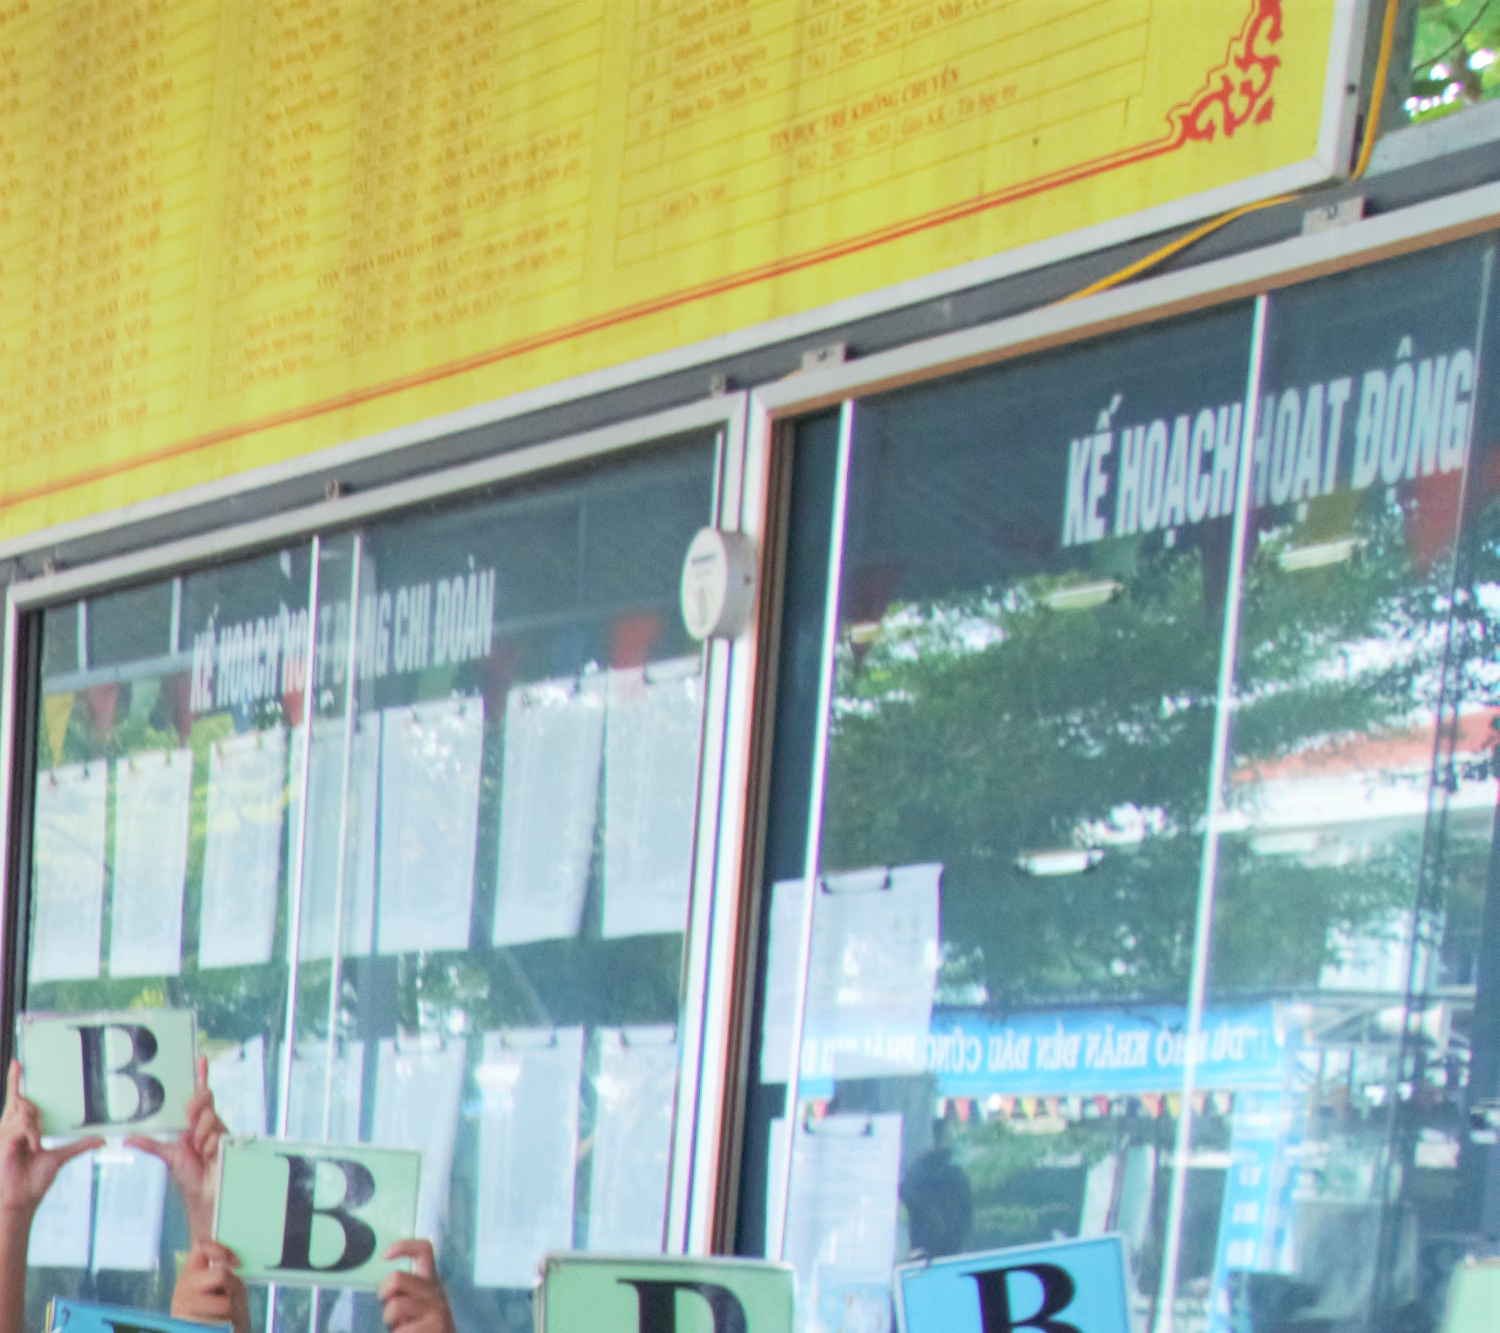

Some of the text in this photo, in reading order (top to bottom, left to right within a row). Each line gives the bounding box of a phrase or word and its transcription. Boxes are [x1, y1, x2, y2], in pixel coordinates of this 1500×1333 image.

[1062, 337, 1475, 548] KẾ HOẠCH HOẠT ĐỘNG
[394, 582, 432, 673] CHI
[434, 553, 495, 667] ĐOÀN
[68, 1022, 166, 1129] B
[265, 1153, 377, 1274] B
